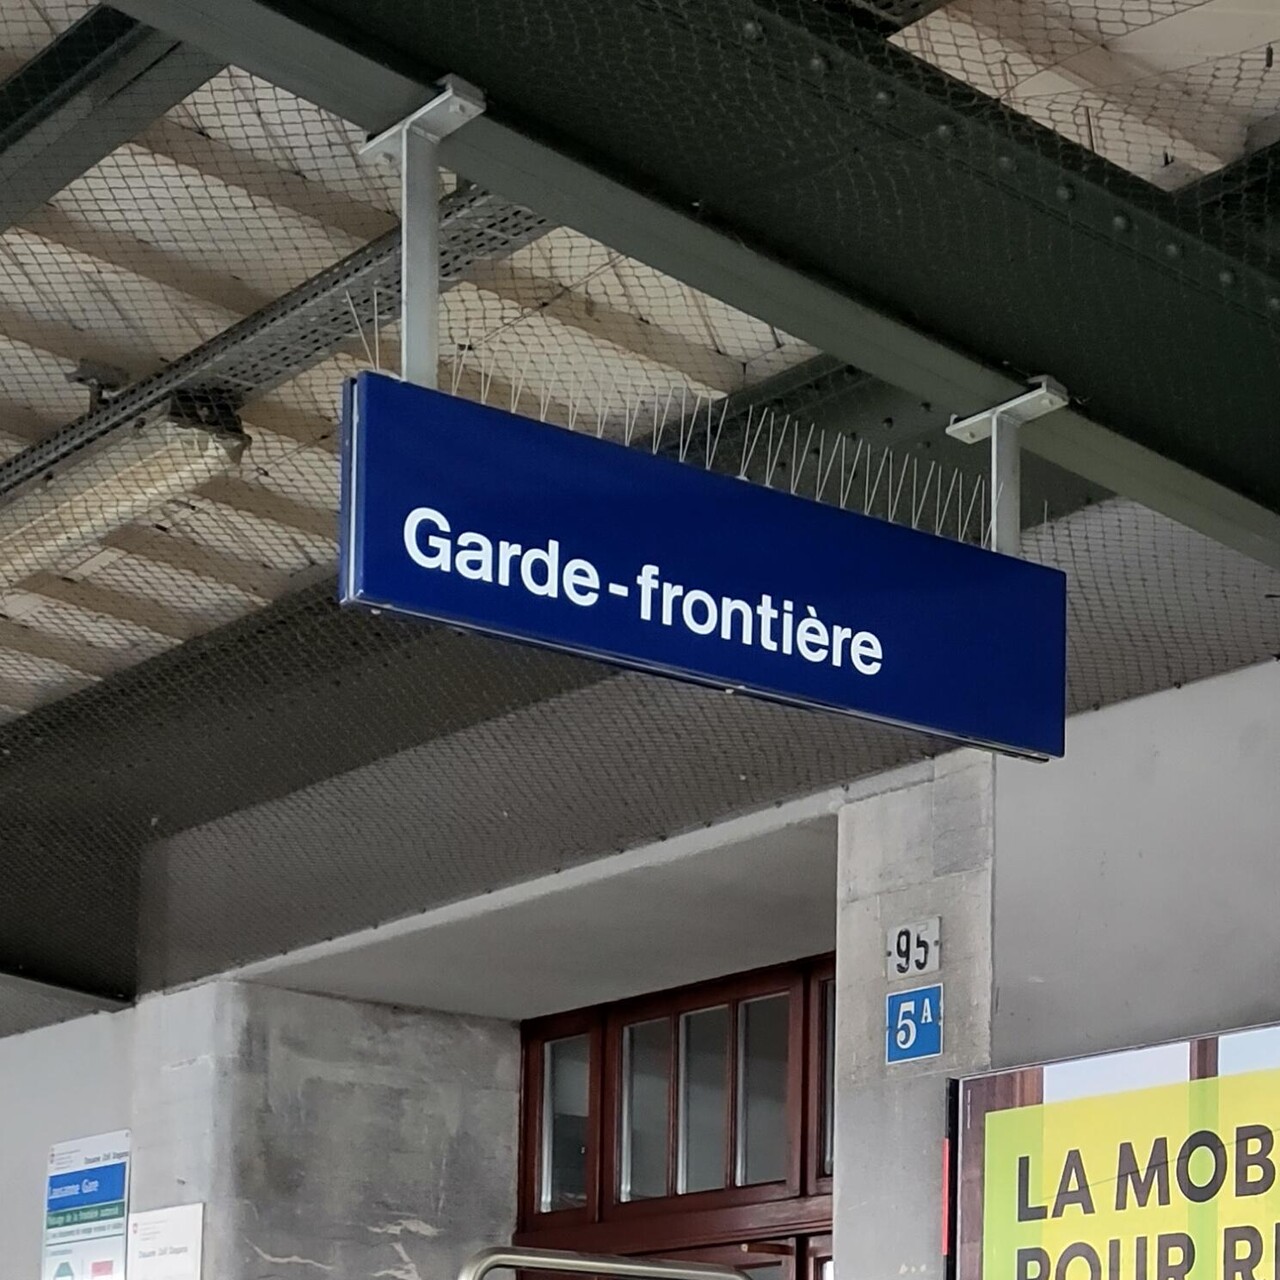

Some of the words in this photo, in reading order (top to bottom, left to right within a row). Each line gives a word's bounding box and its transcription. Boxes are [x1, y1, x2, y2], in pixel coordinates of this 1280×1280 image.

[403, 506, 884, 677] Garde-frontière
[896, 923, 930, 974] 95
[896, 997, 933, 1050] 5A
[1016, 1148, 1096, 1223] LA
